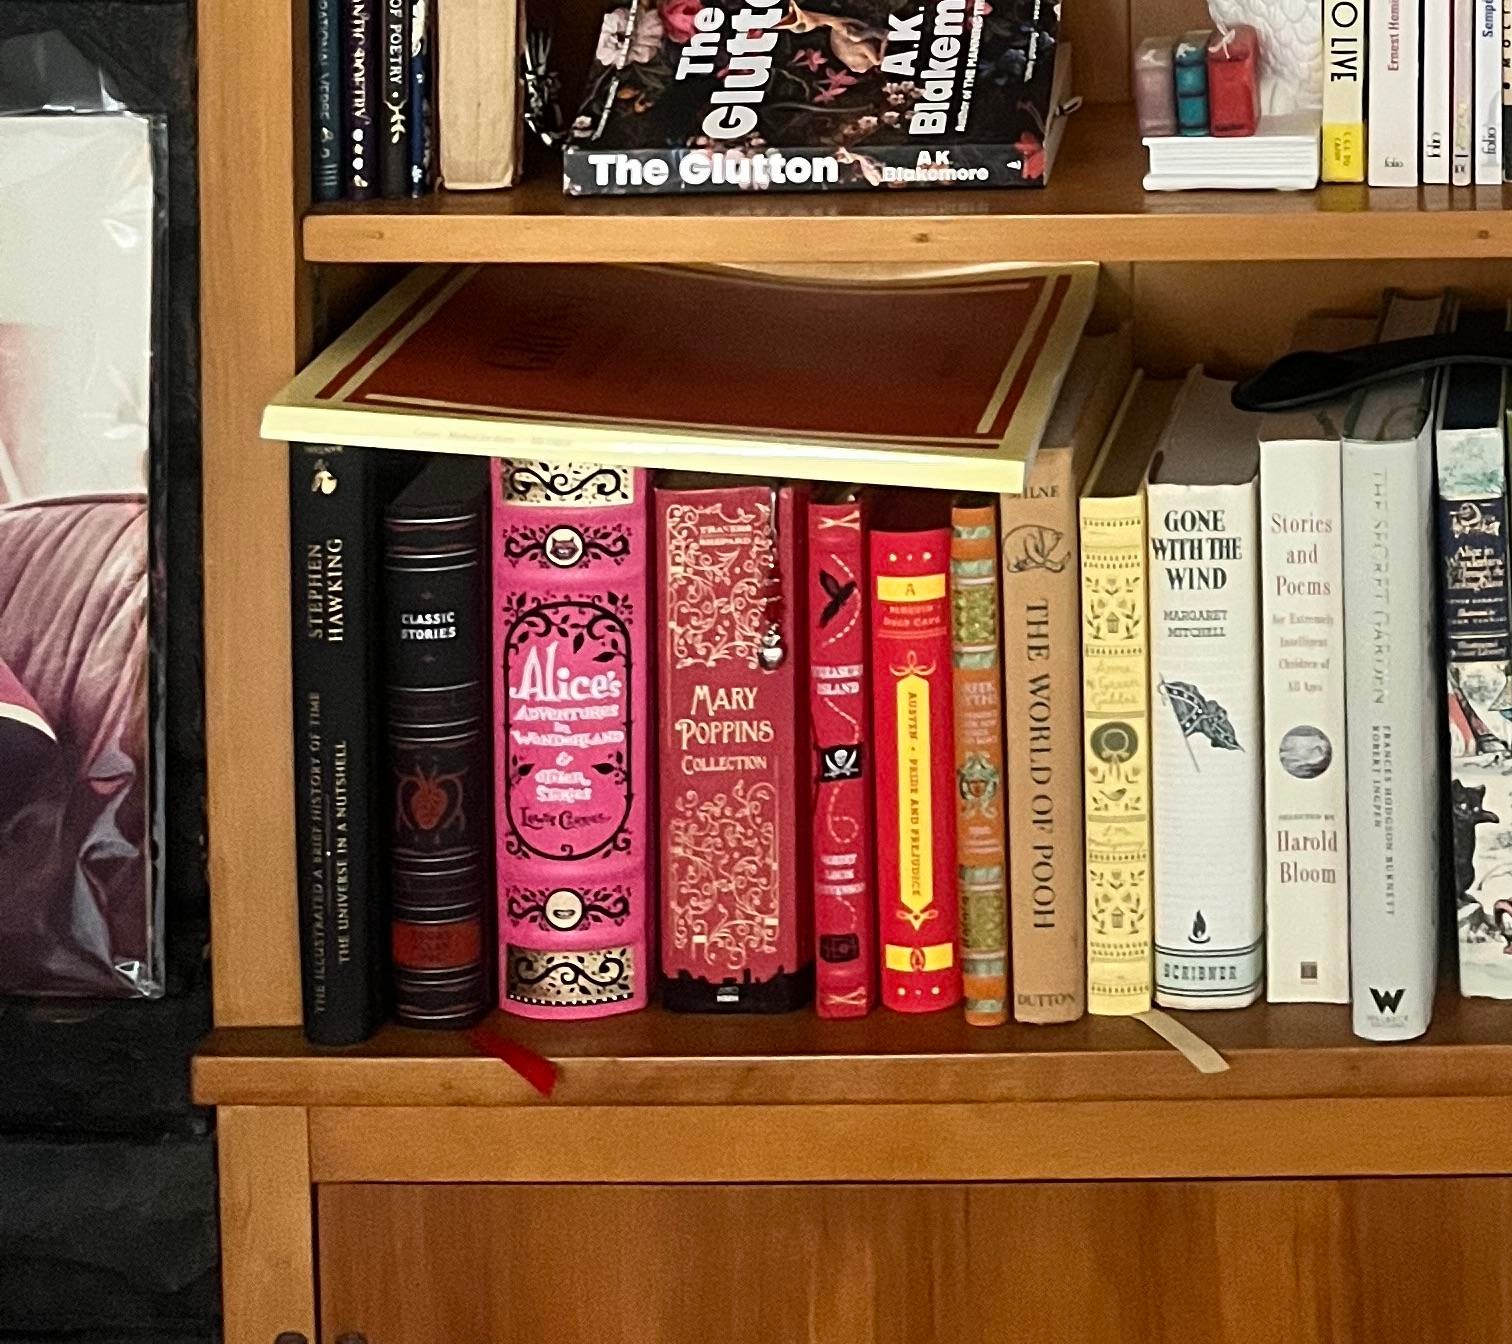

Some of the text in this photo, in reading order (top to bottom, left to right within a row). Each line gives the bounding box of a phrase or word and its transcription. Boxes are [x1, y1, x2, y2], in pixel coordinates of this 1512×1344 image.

[676, 7, 725, 80] The
[881, 6, 924, 76] A.K.
[1330, 37, 1358, 82] LIVE
[588, 153, 838, 184] The Glutton
[1164, 511, 1225, 532] GONE
[1152, 538, 1242, 561] WITH THE
[1165, 568, 1227, 590] WIND
[401, 611, 455, 625] CLASSIC
[401, 626, 456, 640] STORIES
[510, 647, 622, 701] Alice's
[691, 685, 757, 713] MARY
[674, 720, 774, 744] POPPINS
[1277, 830, 1337, 854] Harold
[1280, 863, 1336, 883] Bloom
